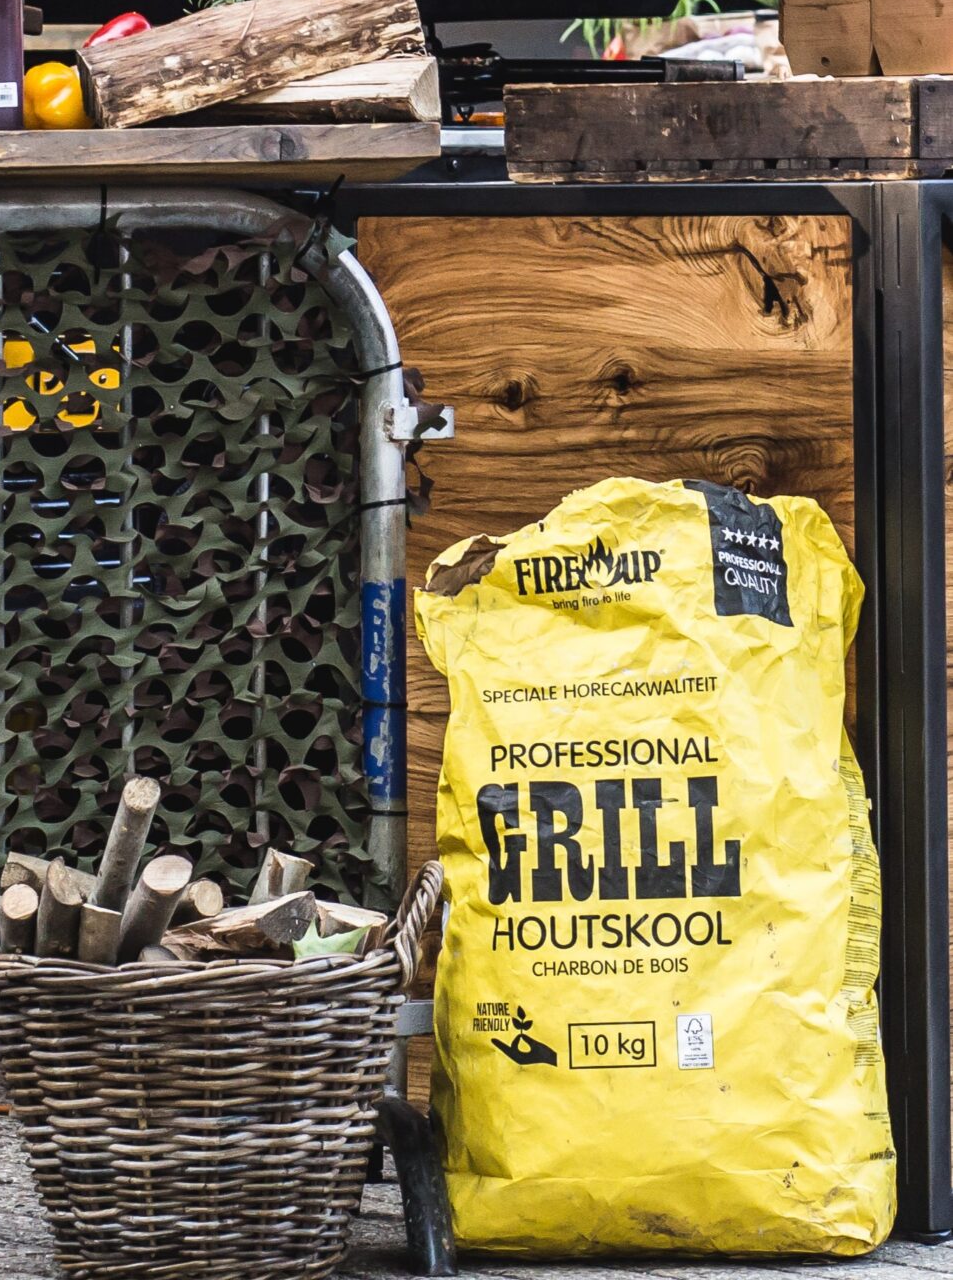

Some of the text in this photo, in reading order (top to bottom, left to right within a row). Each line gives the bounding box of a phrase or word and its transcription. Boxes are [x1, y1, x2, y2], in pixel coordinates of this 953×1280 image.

[513, 551, 662, 596] FIRE UP
[718, 551, 782, 576] PROFESSIONAL
[725, 567, 778, 595] QUALITY
[552, 598, 579, 611] bring
[602, 593, 612, 604] to
[615, 591, 631, 602] life
[483, 676, 718, 703] SPECIALE HORECAKWALITEIT
[491, 736, 719, 772] PROFESSIONAL
[476, 775, 742, 906] GRILL
[492, 910, 733, 952] HOUTSKOOL
[532, 957, 689, 977] CHARBON DE BOIS
[472, 1002, 511, 1032] NATURE FRIENDLY
[581, 1032, 645, 1060] 10 kg
